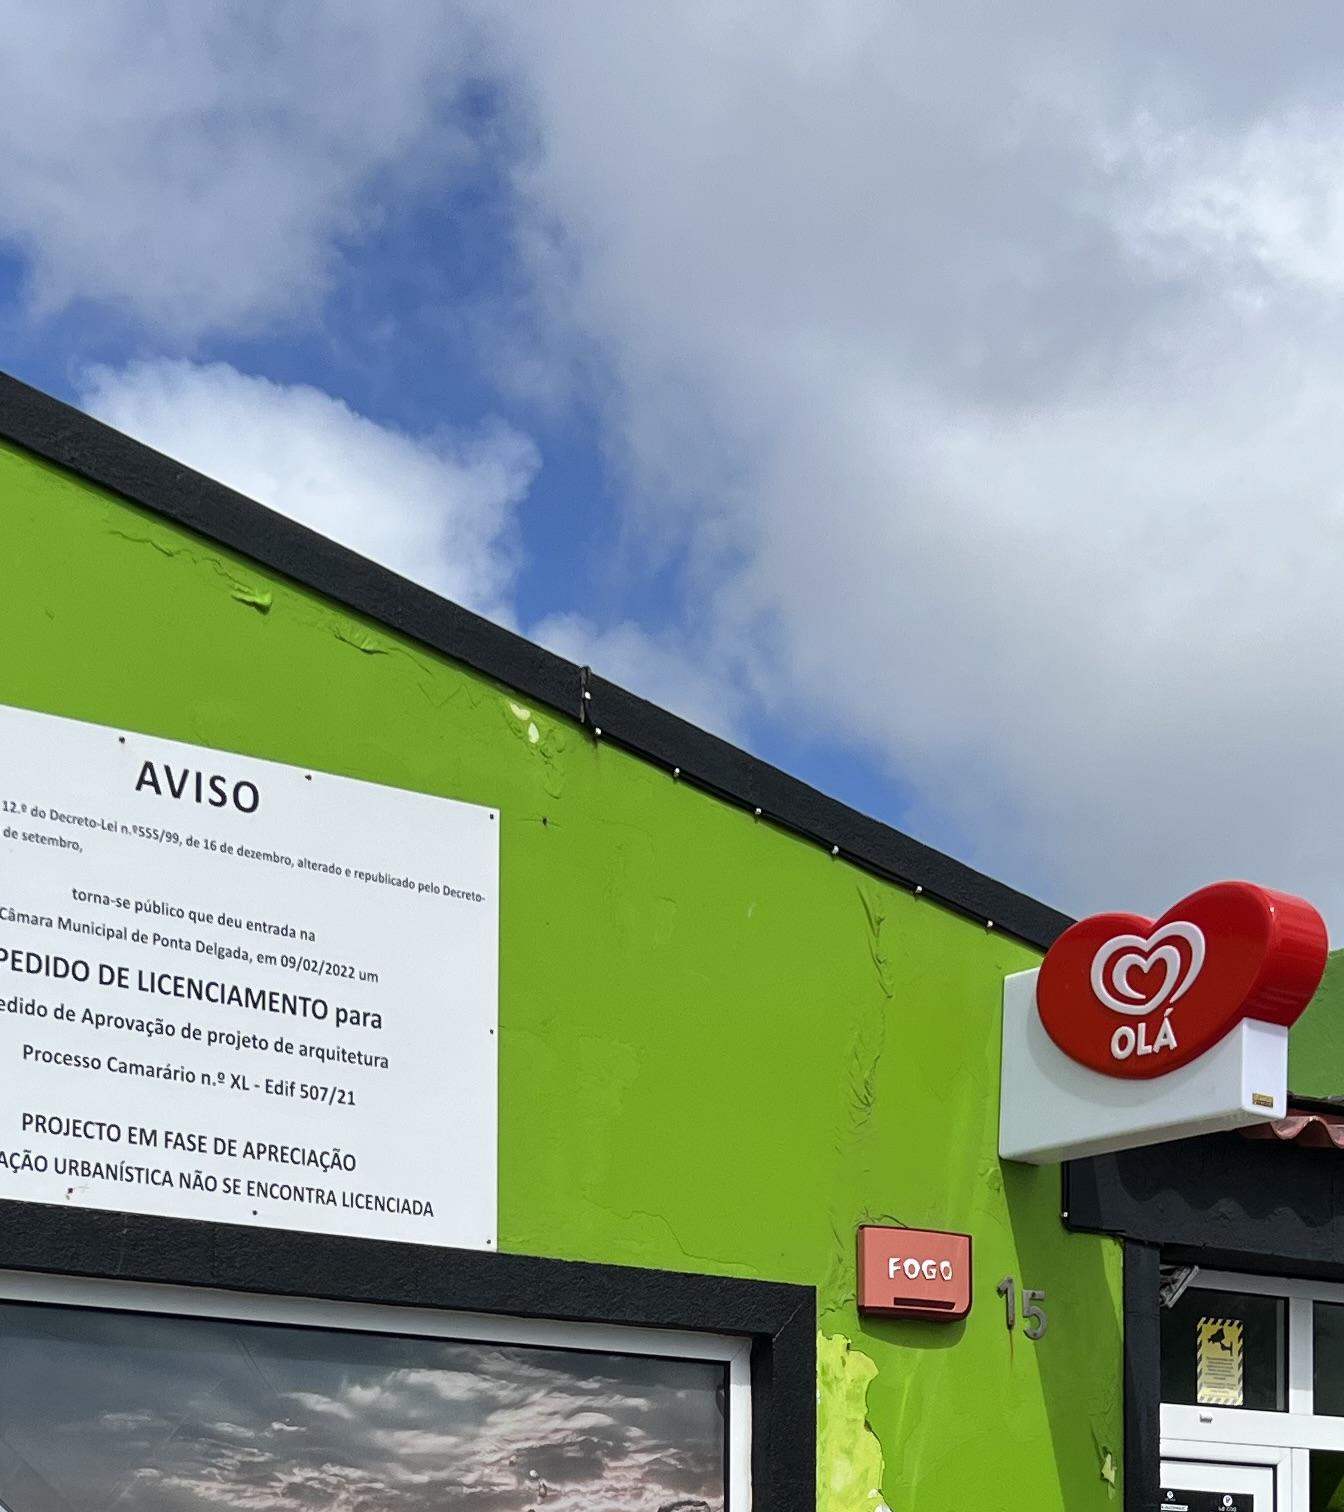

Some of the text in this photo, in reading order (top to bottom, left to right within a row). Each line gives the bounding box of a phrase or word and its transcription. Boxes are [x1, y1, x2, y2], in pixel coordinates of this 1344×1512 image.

[134, 759, 260, 814] AVISO
[2, 826, 19, 840] de
[21, 831, 83, 854] setembro,
[30, 805, 47, 820] do
[49, 808, 118, 833] Decreto-Lei
[185, 834, 201, 849] de
[203, 838, 218, 852] 16
[219, 841, 234, 855] de
[236, 844, 295, 868] dezembro,
[296, 857, 343, 876] alterado
[344, 868, 352, 878] e
[353, 869, 416, 890] republicado
[417, 881, 441, 895] pelo
[442, 884, 486, 903] Decreto-
[71, 887, 316, 943] torna-se público que deu entrada na
[57, 916, 128, 942] Municipal
[130, 928, 149, 945] de
[152, 932, 192, 952] Ponta
[195, 939, 253, 965] Delgada,
[256, 953, 278, 966] em
[280, 954, 356, 980] 09/02/2022
[358, 970, 379, 984] um
[98, 963, 130, 990] DE
[137, 969, 329, 1021] LICENCIAMENTO
[335, 1006, 383, 1030] para
[53, 1002, 77, 1023] de
[80, 1007, 176, 1038] Aprovação
[180, 1021, 202, 1042] de
[207, 1030, 269, 1051] projeto
[273, 1036, 295, 1055] de
[298, 1043, 389, 1070] arquitetura
[1110, 1006, 1178, 1061] OLÁ
[22, 1043, 102, 1071] Processo
[106, 1056, 196, 1084] Camarário
[229, 1072, 251, 1092] XL
[265, 1078, 297, 1098] Edif
[299, 1083, 356, 1107] 507/21
[22, 1112, 357, 1174] PROJECTO EM FASE DE APRECIAÇÃO
[53, 1156, 175, 1188] URBANÍSTICA
[178, 1168, 218, 1193] NÃO
[222, 1176, 242, 1196] SE
[246, 1179, 338, 1207] ENCONTRA
[341, 1190, 435, 1218] LICENCIADA
[887, 1256, 954, 1281] FOGO
[996, 1275, 1049, 1341] 15
